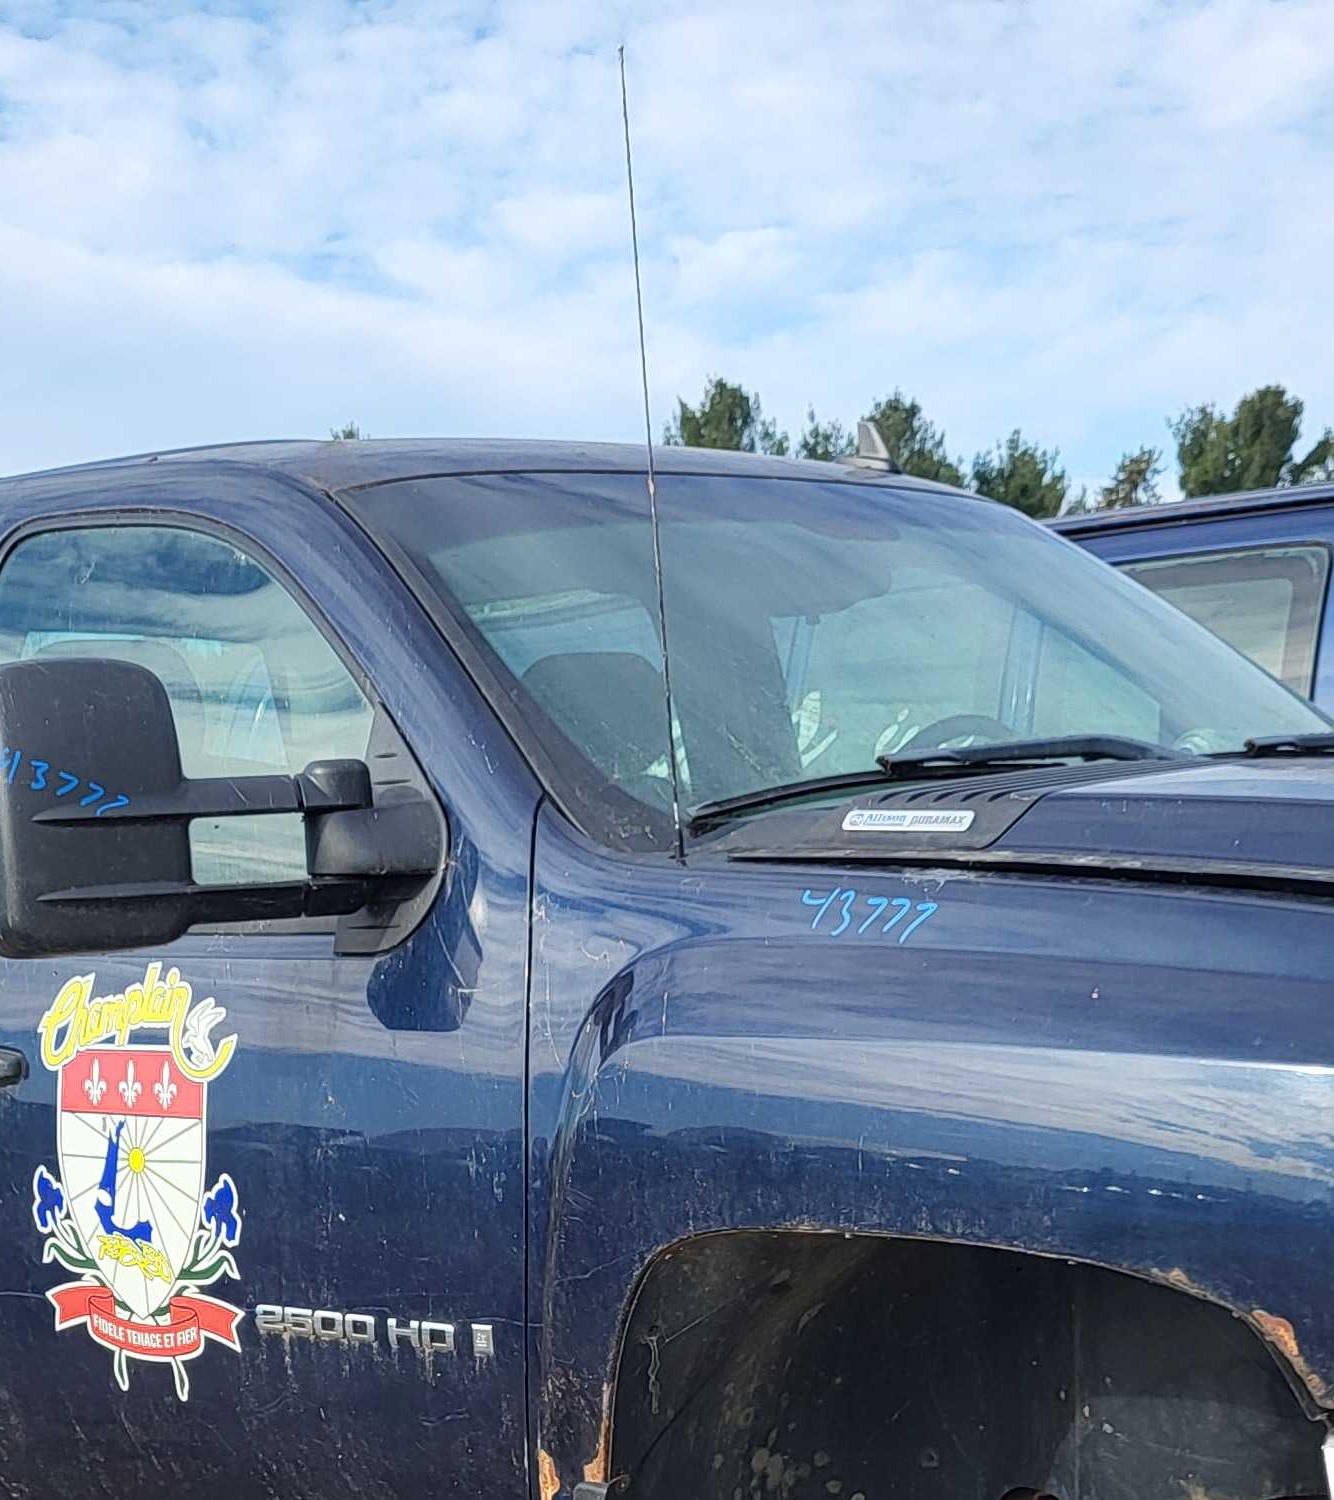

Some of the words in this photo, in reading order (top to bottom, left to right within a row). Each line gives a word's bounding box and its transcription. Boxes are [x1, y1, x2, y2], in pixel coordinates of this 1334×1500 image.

[908, 814, 967, 827] DURAMAX
[802, 887, 939, 944] 43777
[41, 962, 238, 1081] Champlain
[163, 1332, 175, 1348] ET
[176, 1326, 197, 1347] FIER
[255, 1304, 376, 1344] 2500
[387, 1318, 455, 1352] HD
